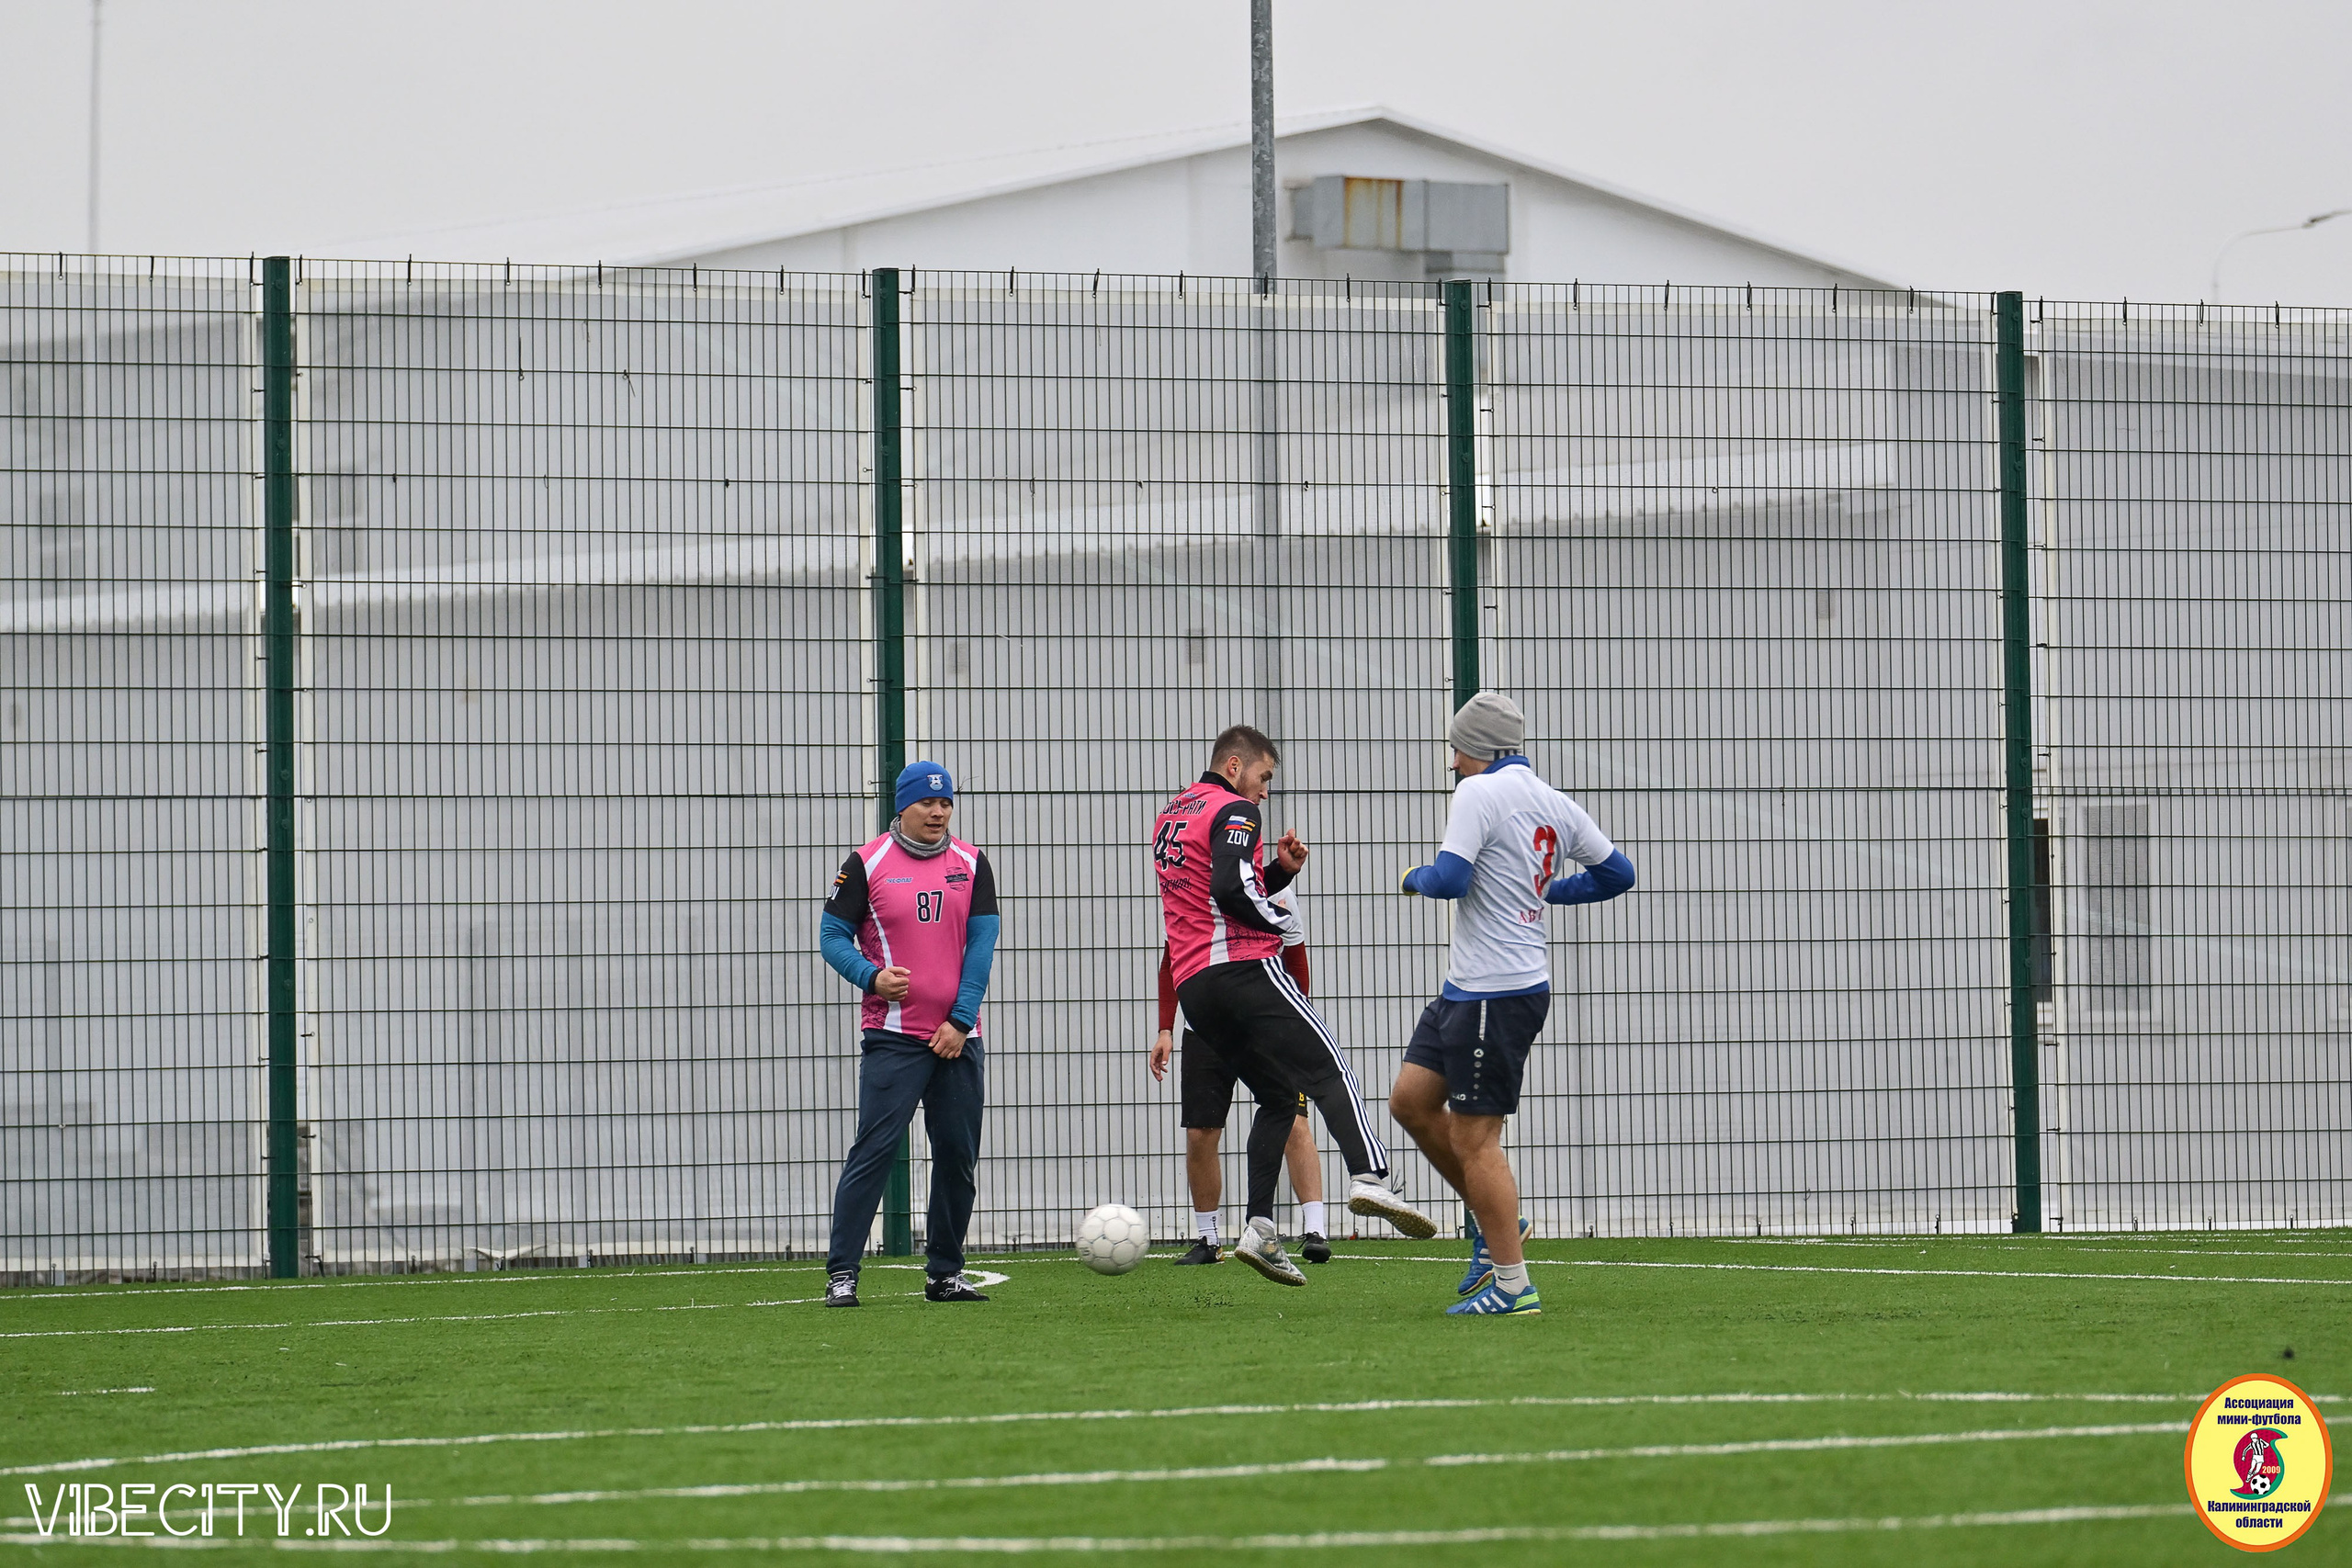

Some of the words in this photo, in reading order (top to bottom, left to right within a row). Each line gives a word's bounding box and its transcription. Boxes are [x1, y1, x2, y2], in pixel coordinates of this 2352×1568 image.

[1154, 819, 1189, 872] 45
[1227, 829, 1250, 848] ZOV
[1532, 825, 1557, 898] 3
[916, 889, 944, 923] 87
